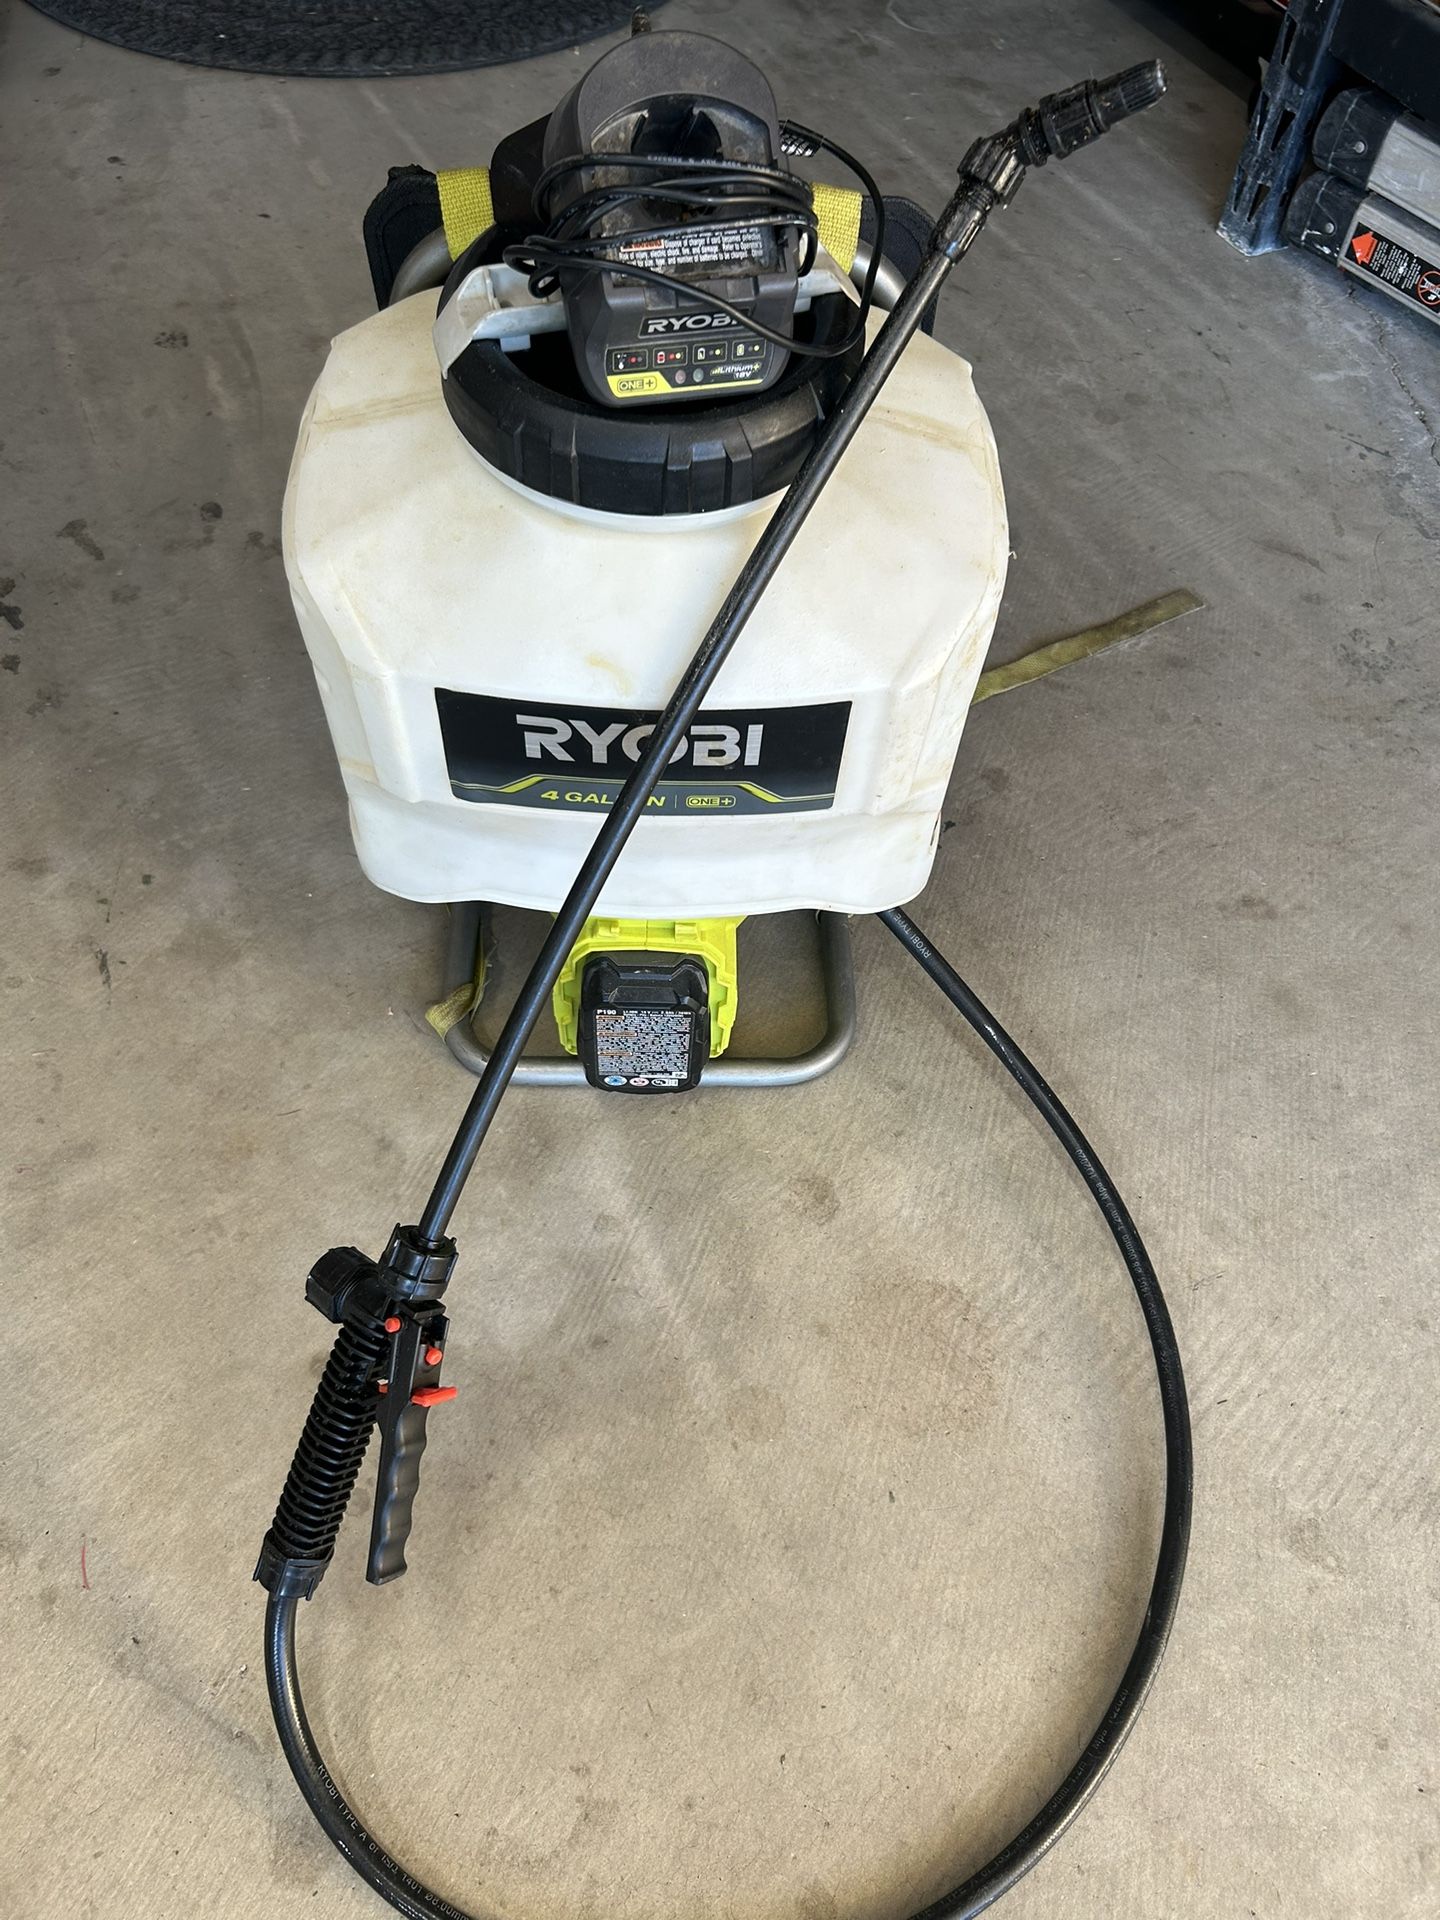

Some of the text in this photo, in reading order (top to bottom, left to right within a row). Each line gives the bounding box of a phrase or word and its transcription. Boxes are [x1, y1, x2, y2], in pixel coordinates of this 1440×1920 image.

[735, 371, 752, 379] 18V
[515, 714, 764, 766] RYOBI
[540, 790, 666, 807] 4 GALN
[893, 913, 932, 959] RYOBI TYPE
[318, 1764, 340, 1800] RYOBI
[339, 1802, 359, 1830] TYPE
[359, 1831, 368, 1842] A
